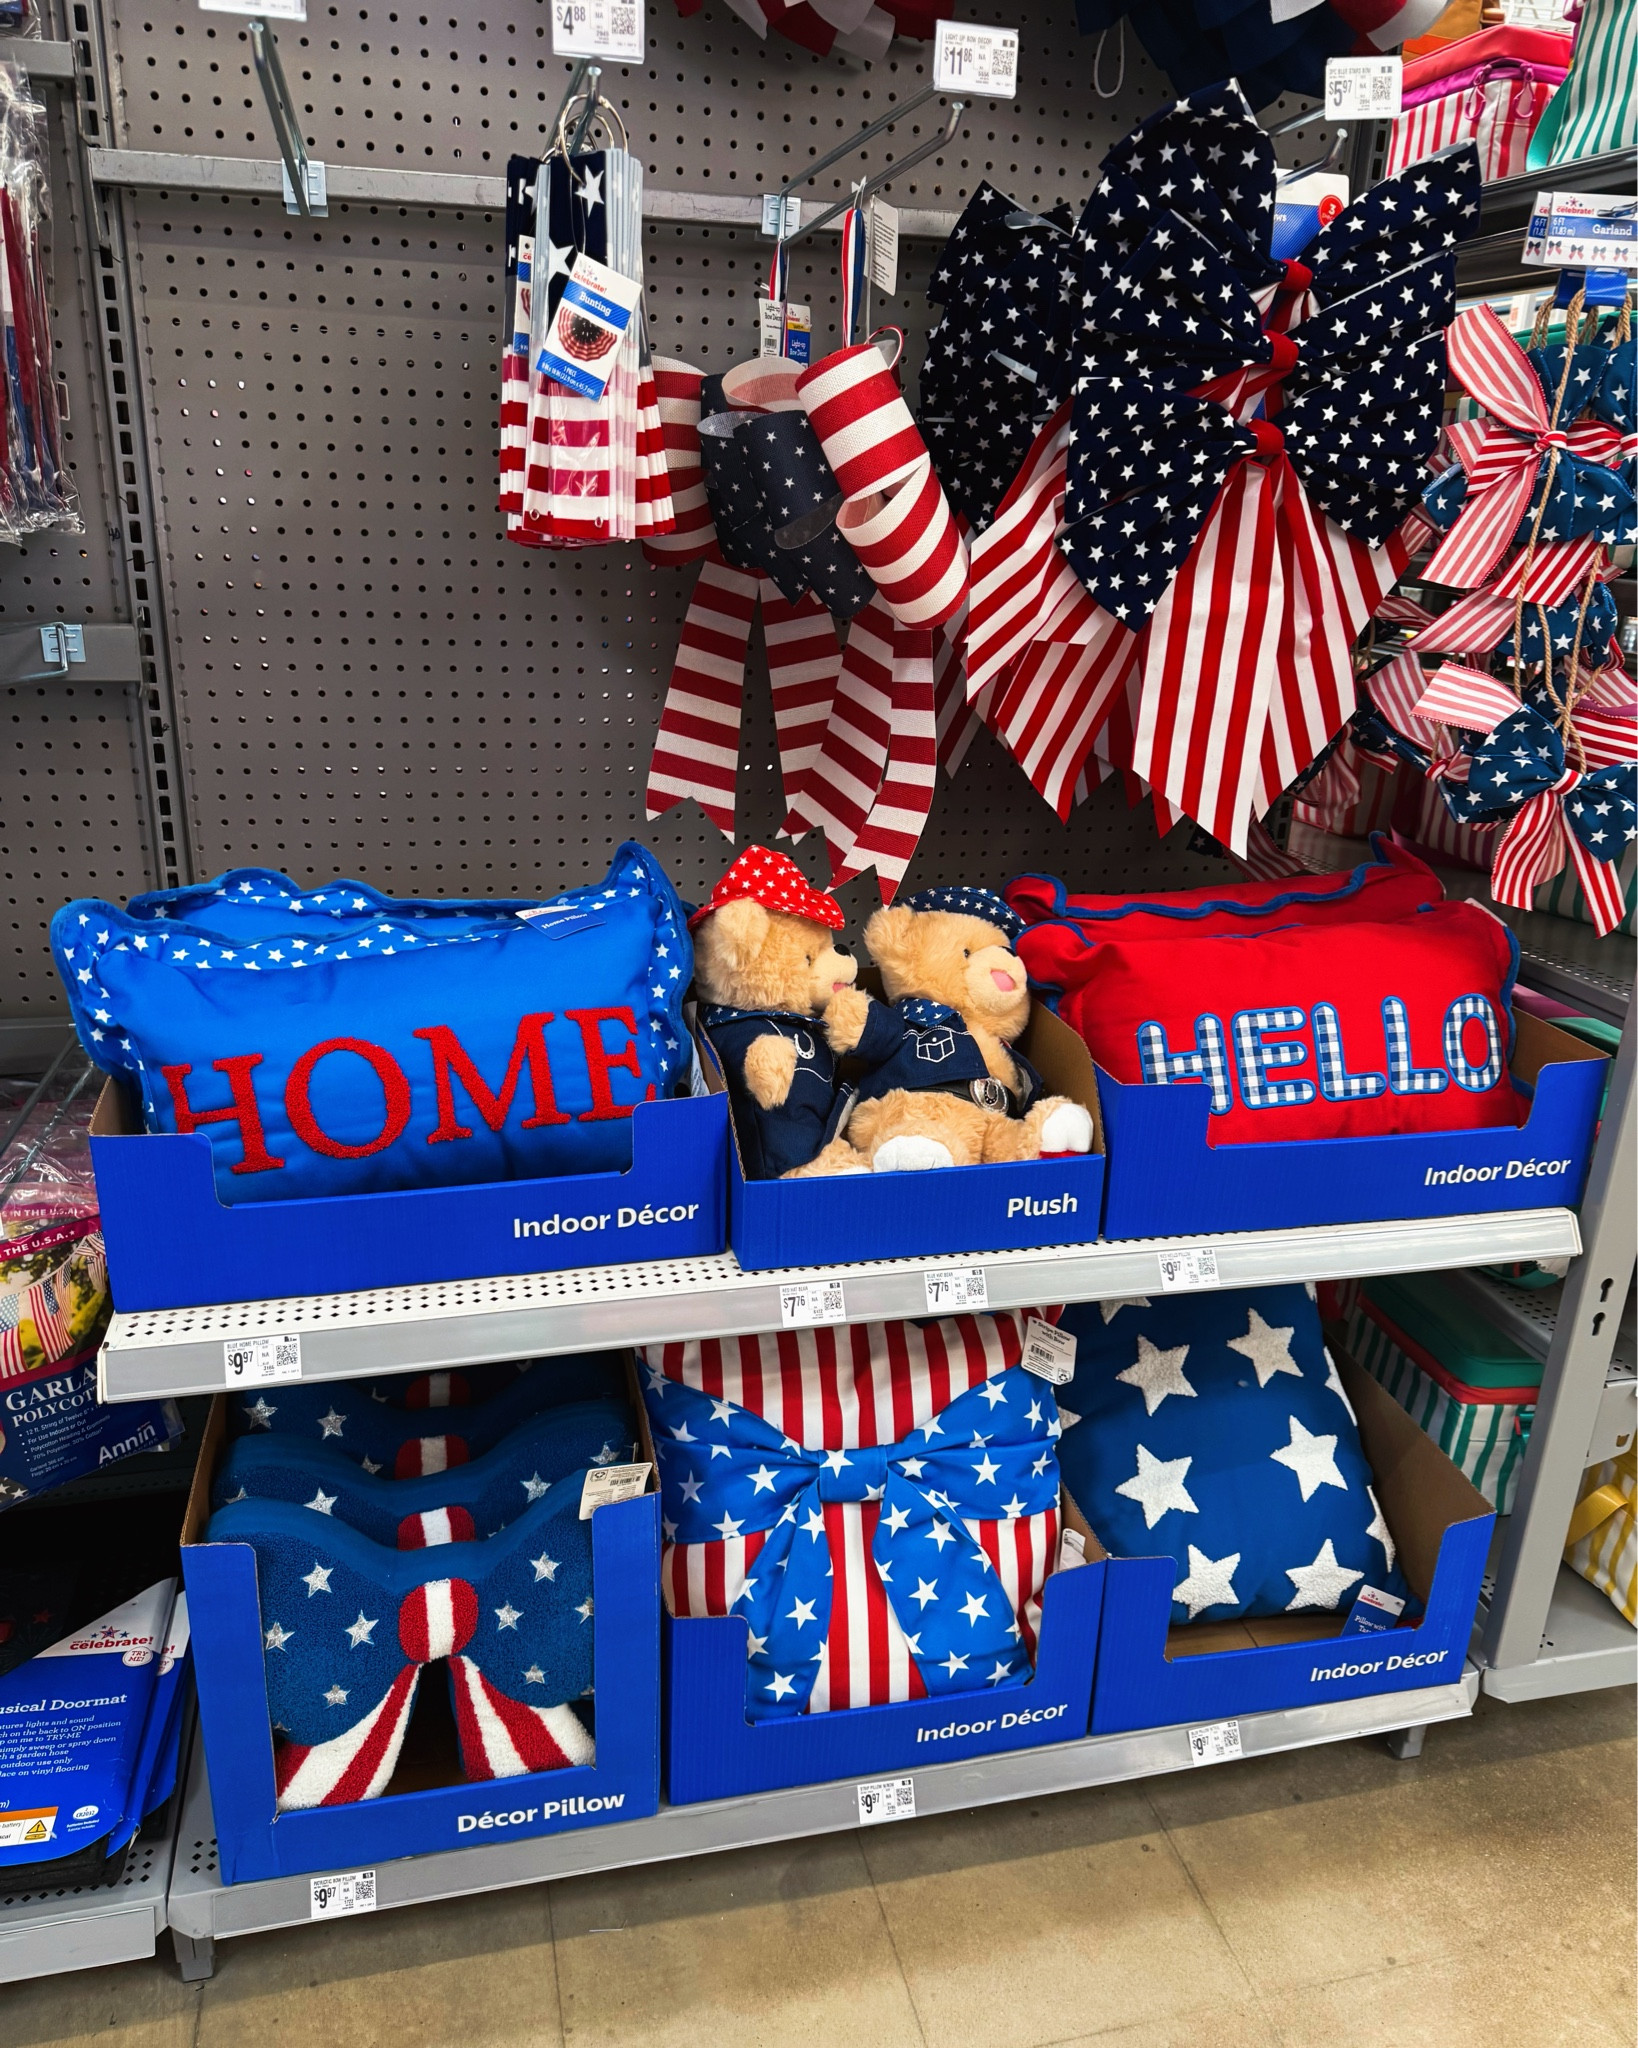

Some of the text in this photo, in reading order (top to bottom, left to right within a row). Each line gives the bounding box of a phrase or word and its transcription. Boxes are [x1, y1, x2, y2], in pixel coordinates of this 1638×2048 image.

[1328, 203, 1337, 216] 3
[1556, 206, 1595, 215] celebrate!
[1592, 224, 1633, 236] Garland
[573, 270, 608, 294] celebrate!
[579, 291, 612, 317] Bunting
[1137, 993, 1503, 1116] HELLO
[161, 1005, 657, 1175] HOME
[1424, 1158, 1572, 1186] Indoor Décor
[24, 1208, 46, 1217] THE
[1007, 1192, 1078, 1218] Plush
[513, 1203, 700, 1239] Indoor Décor
[3, 1232, 69, 1257] THE U.S.A.
[252, 1338, 269, 1346] PILLOW
[6, 1360, 98, 1412] GARLA
[41, 1420, 58, 1431] String
[49, 1425, 70, 1437] Indoors
[99, 1421, 156, 1466] Annin
[70, 1637, 154, 1651] celebrate!
[1310, 1650, 1449, 1682] Indoor Décor
[49, 1694, 128, 1711] Doormat
[22, 1728, 36, 1736] the
[39, 1726, 59, 1735] back
[71, 1724, 86, 1732] ON
[87, 1720, 121, 1732] position
[25, 1714, 95, 1729] lights and sound
[917, 1703, 1069, 1743] Indoor Décor
[28, 1743, 56, 1754] sweep
[68, 1739, 92, 1749] spray
[93, 1736, 117, 1744] down
[35, 1734, 44, 1742] to
[47, 1731, 82, 1741] TRY-ME
[1, 1759, 36, 1769] outdoor
[53, 1756, 73, 1765] only
[16, 1750, 47, 1760] garden
[48, 1749, 70, 1757] hose
[31, 1765, 55, 1775] vinyl
[55, 1763, 90, 1773] flooring
[458, 1794, 625, 1833] Décor Pillow
